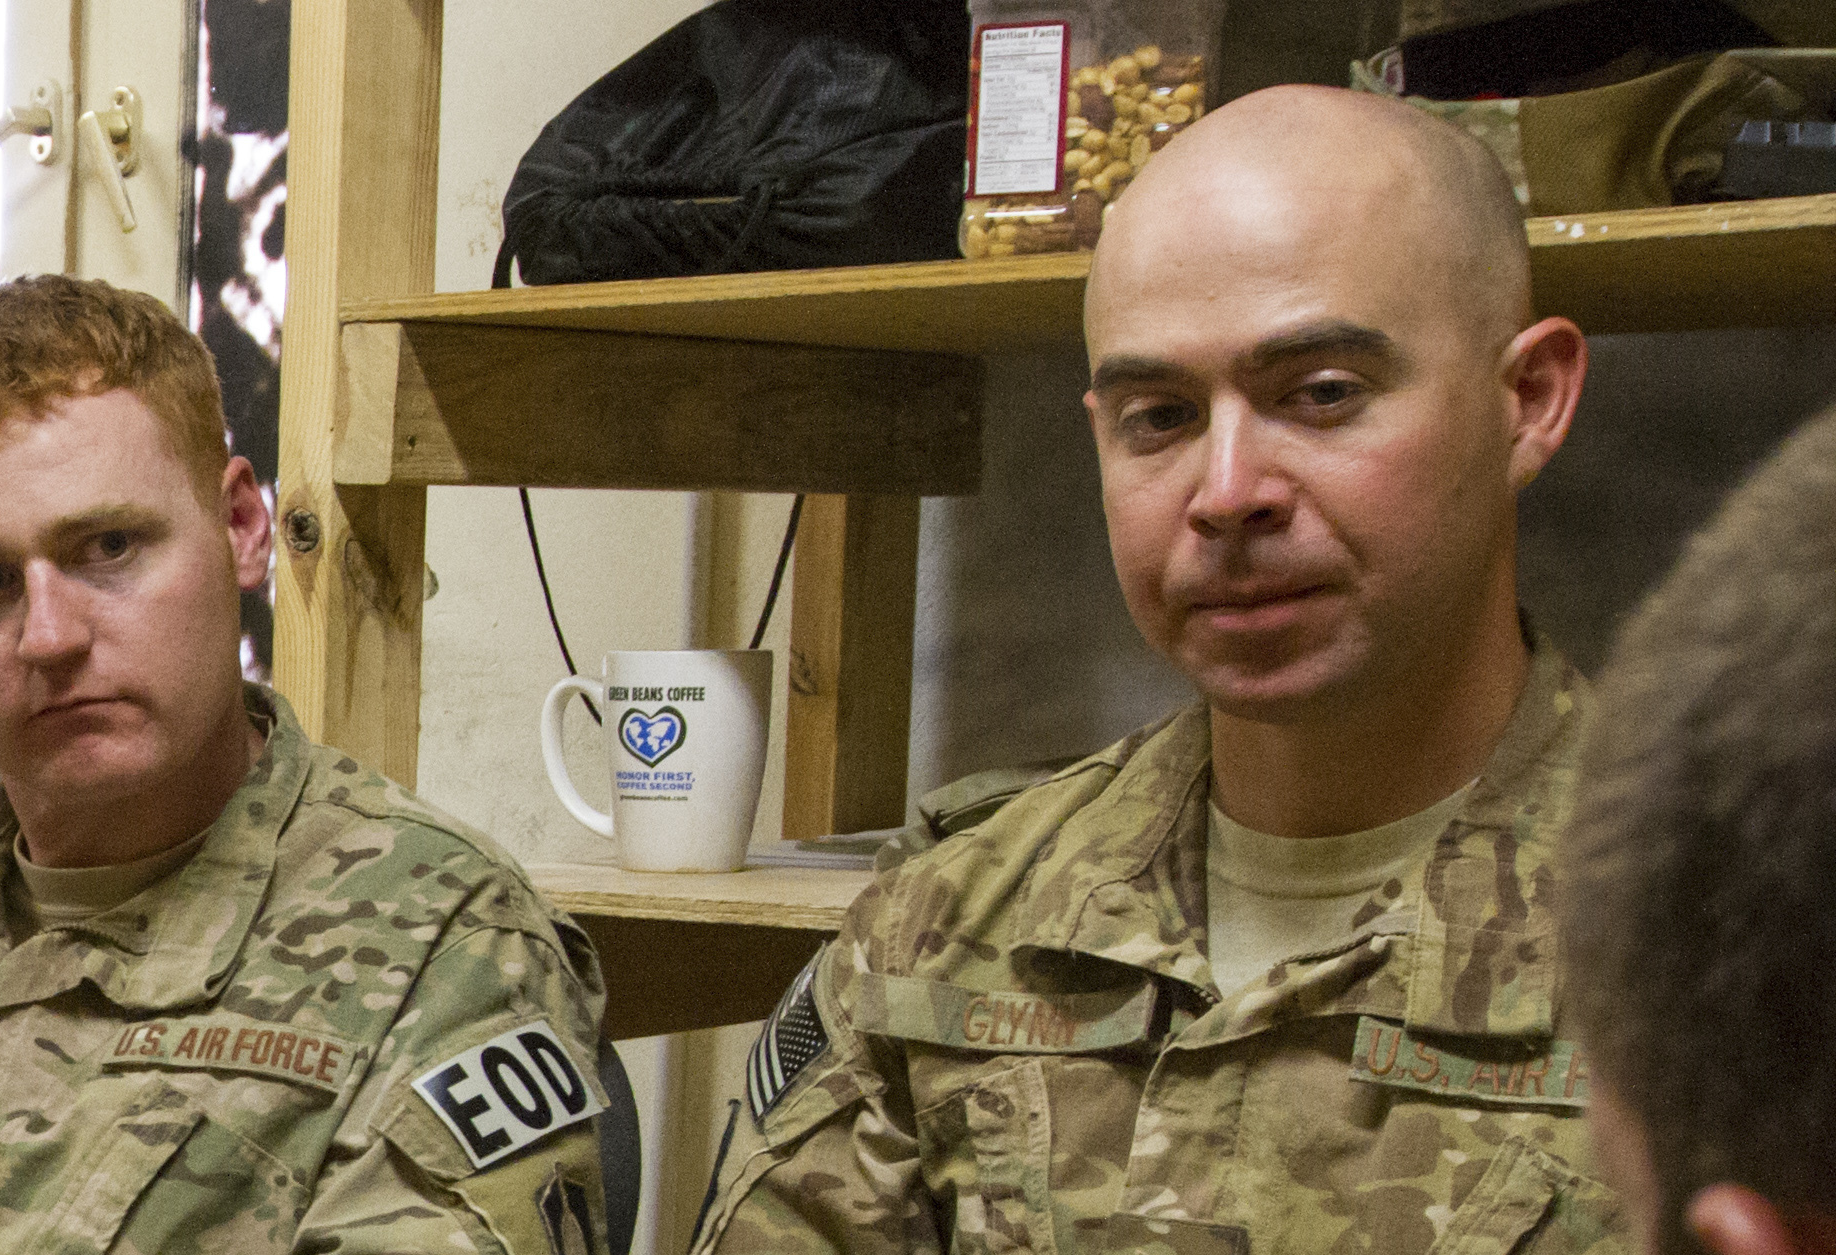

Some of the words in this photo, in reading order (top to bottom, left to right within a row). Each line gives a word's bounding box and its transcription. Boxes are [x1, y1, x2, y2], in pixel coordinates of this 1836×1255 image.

[985, 31, 1029, 41] Nutrition
[632, 686, 663, 701] BEANS
[667, 686, 706, 701] COFFEE
[616, 771, 650, 780] HONOR
[617, 782, 647, 790] COFFEE
[649, 783, 692, 791] SECOND
[964, 996, 1078, 1046] GLYNN
[173, 1026, 230, 1060] AIR
[231, 1027, 345, 1083] FORCE
[1367, 1028, 1450, 1088] U.S.
[422, 1031, 588, 1159] EOD
